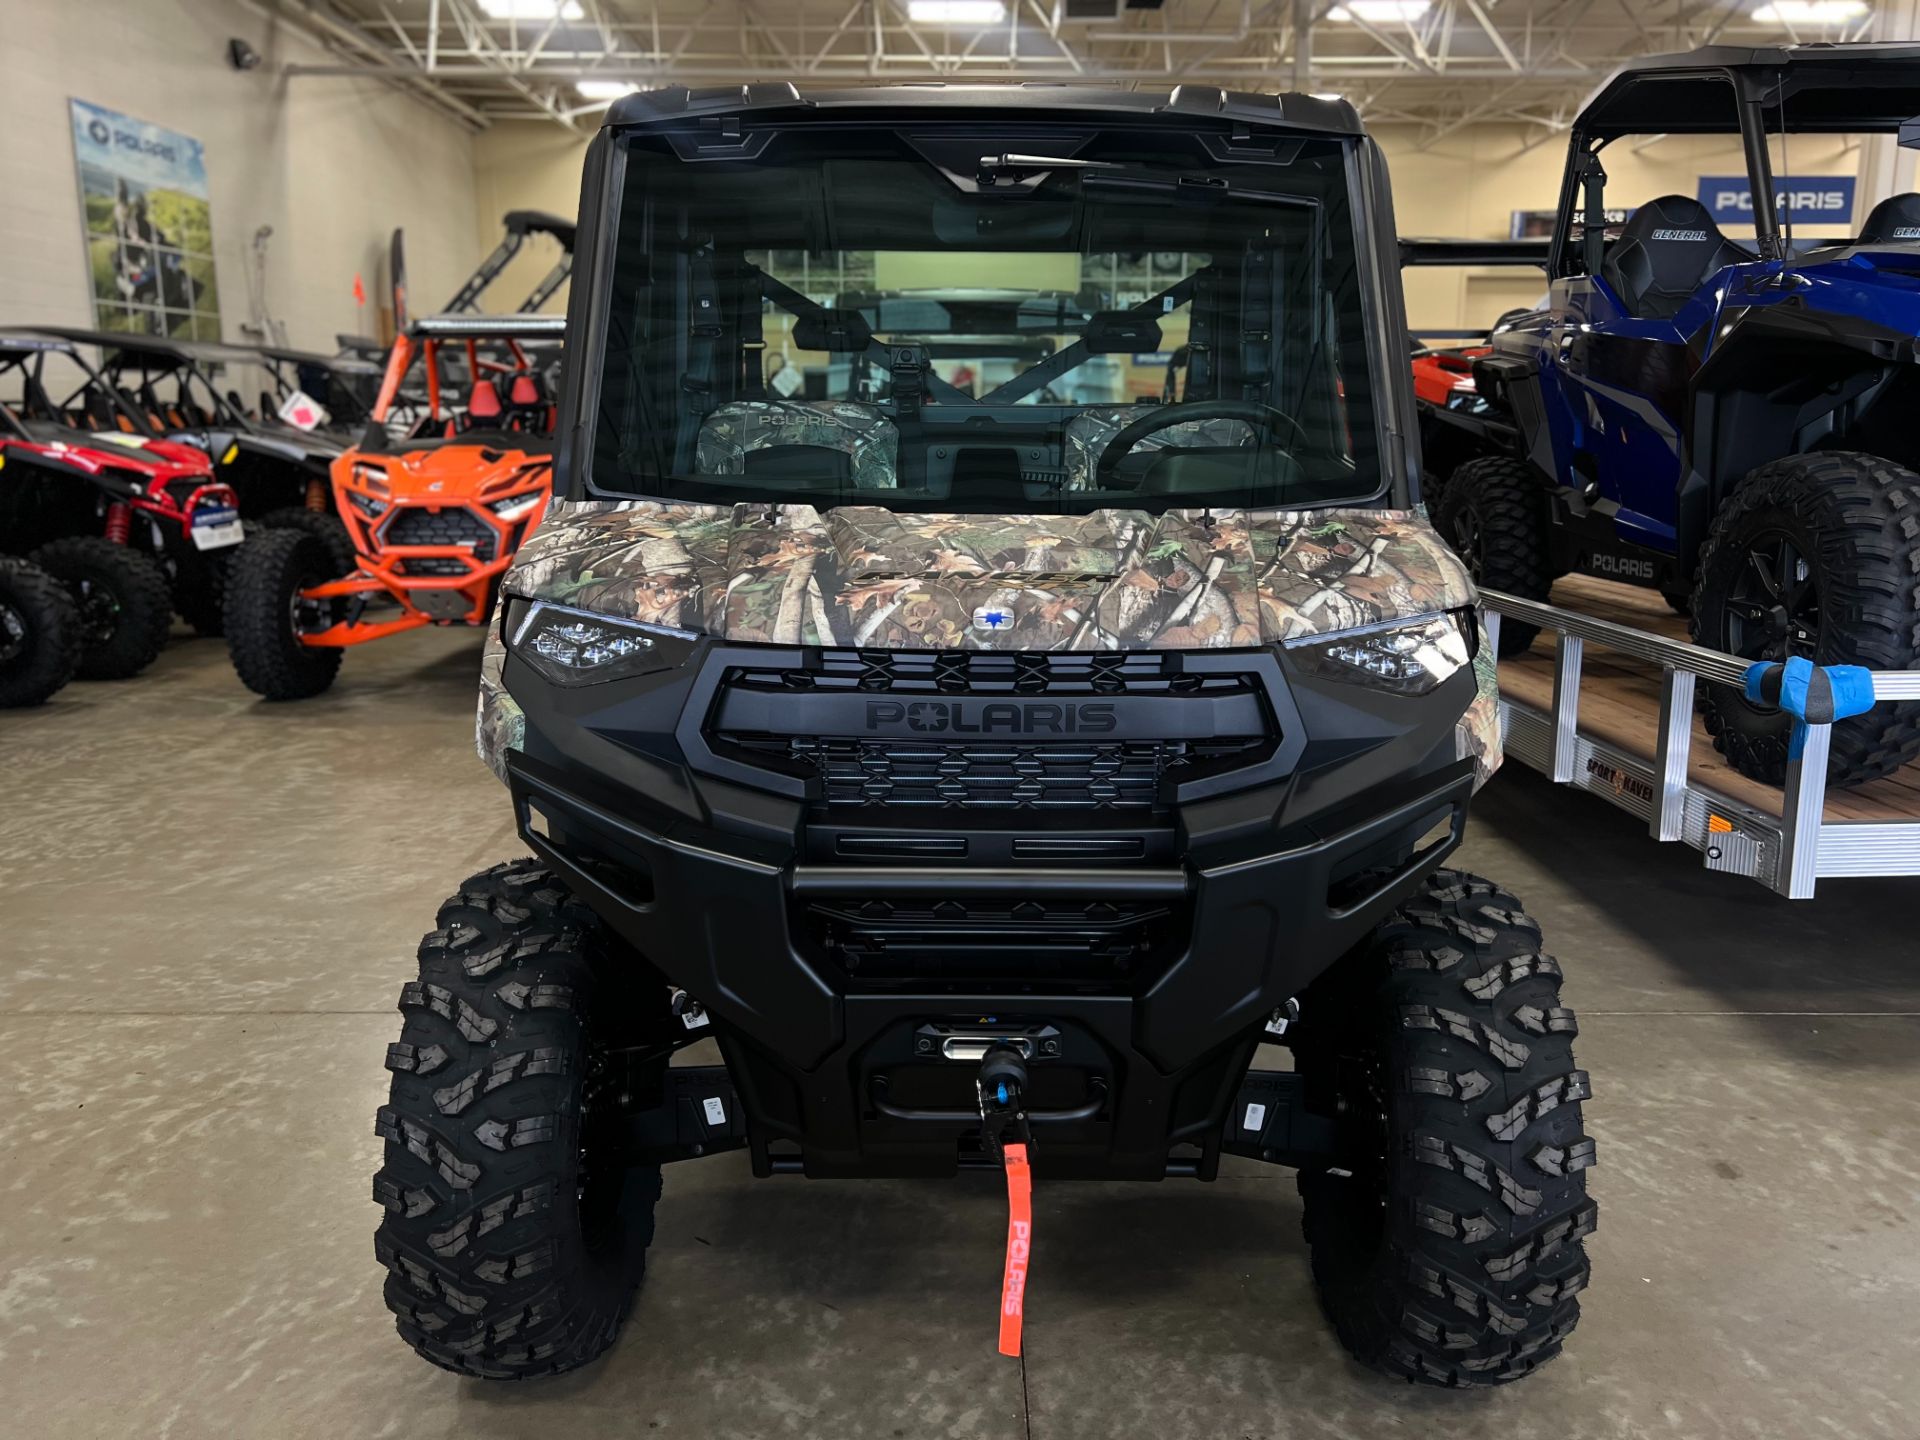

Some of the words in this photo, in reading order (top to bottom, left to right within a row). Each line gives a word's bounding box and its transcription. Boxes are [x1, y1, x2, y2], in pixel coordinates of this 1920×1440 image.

[113, 130, 176, 162] POLARIS
[1715, 191, 1845, 211] POARIS
[1651, 229, 1707, 241] GENERAL
[1892, 226, 1920, 238] GEN
[758, 415, 838, 428] POLARIS
[1592, 553, 1654, 579] POLARIS
[866, 701, 1117, 733] POLARIS
[1586, 758, 1616, 784] SPORT
[1004, 1219, 1029, 1317] POLARIS
